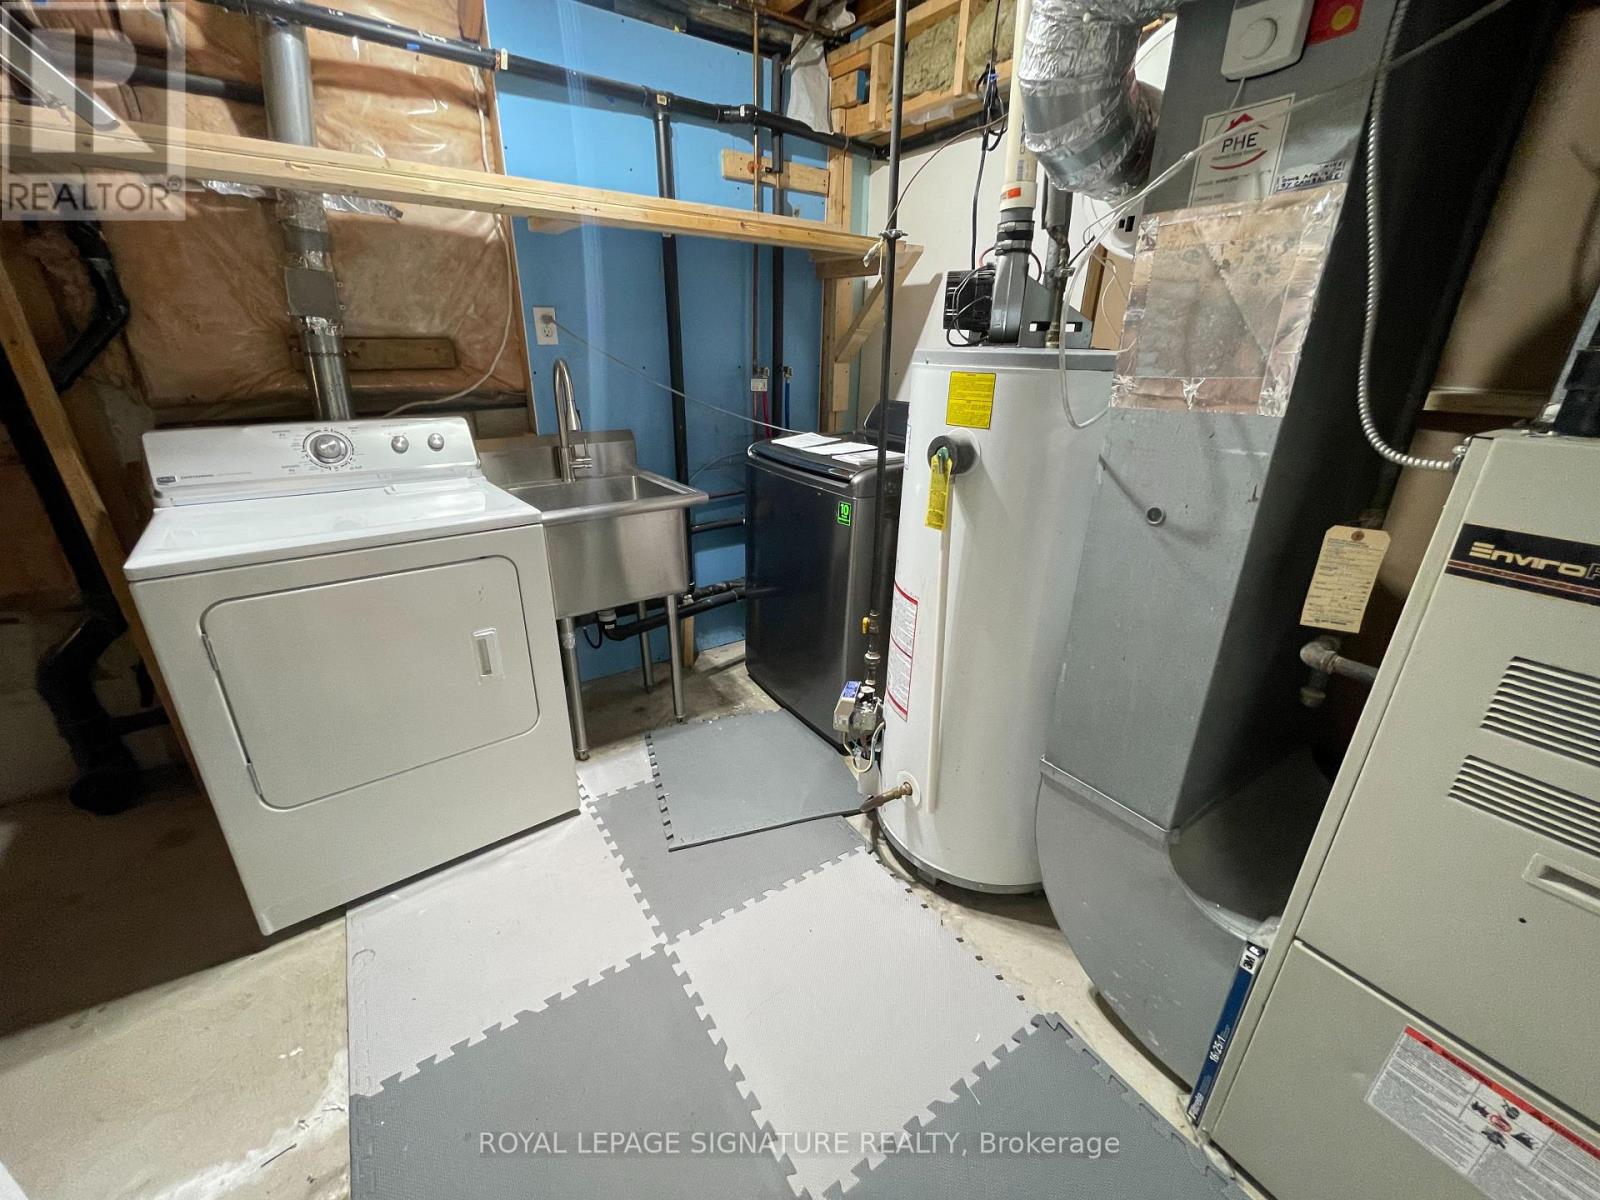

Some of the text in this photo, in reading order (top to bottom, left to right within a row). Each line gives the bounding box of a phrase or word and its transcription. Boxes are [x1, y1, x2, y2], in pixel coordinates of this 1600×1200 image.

[1221, 132, 1259, 153] PHE
[840, 503, 850, 516] 10
[1242, 954, 1256, 971] 3M
